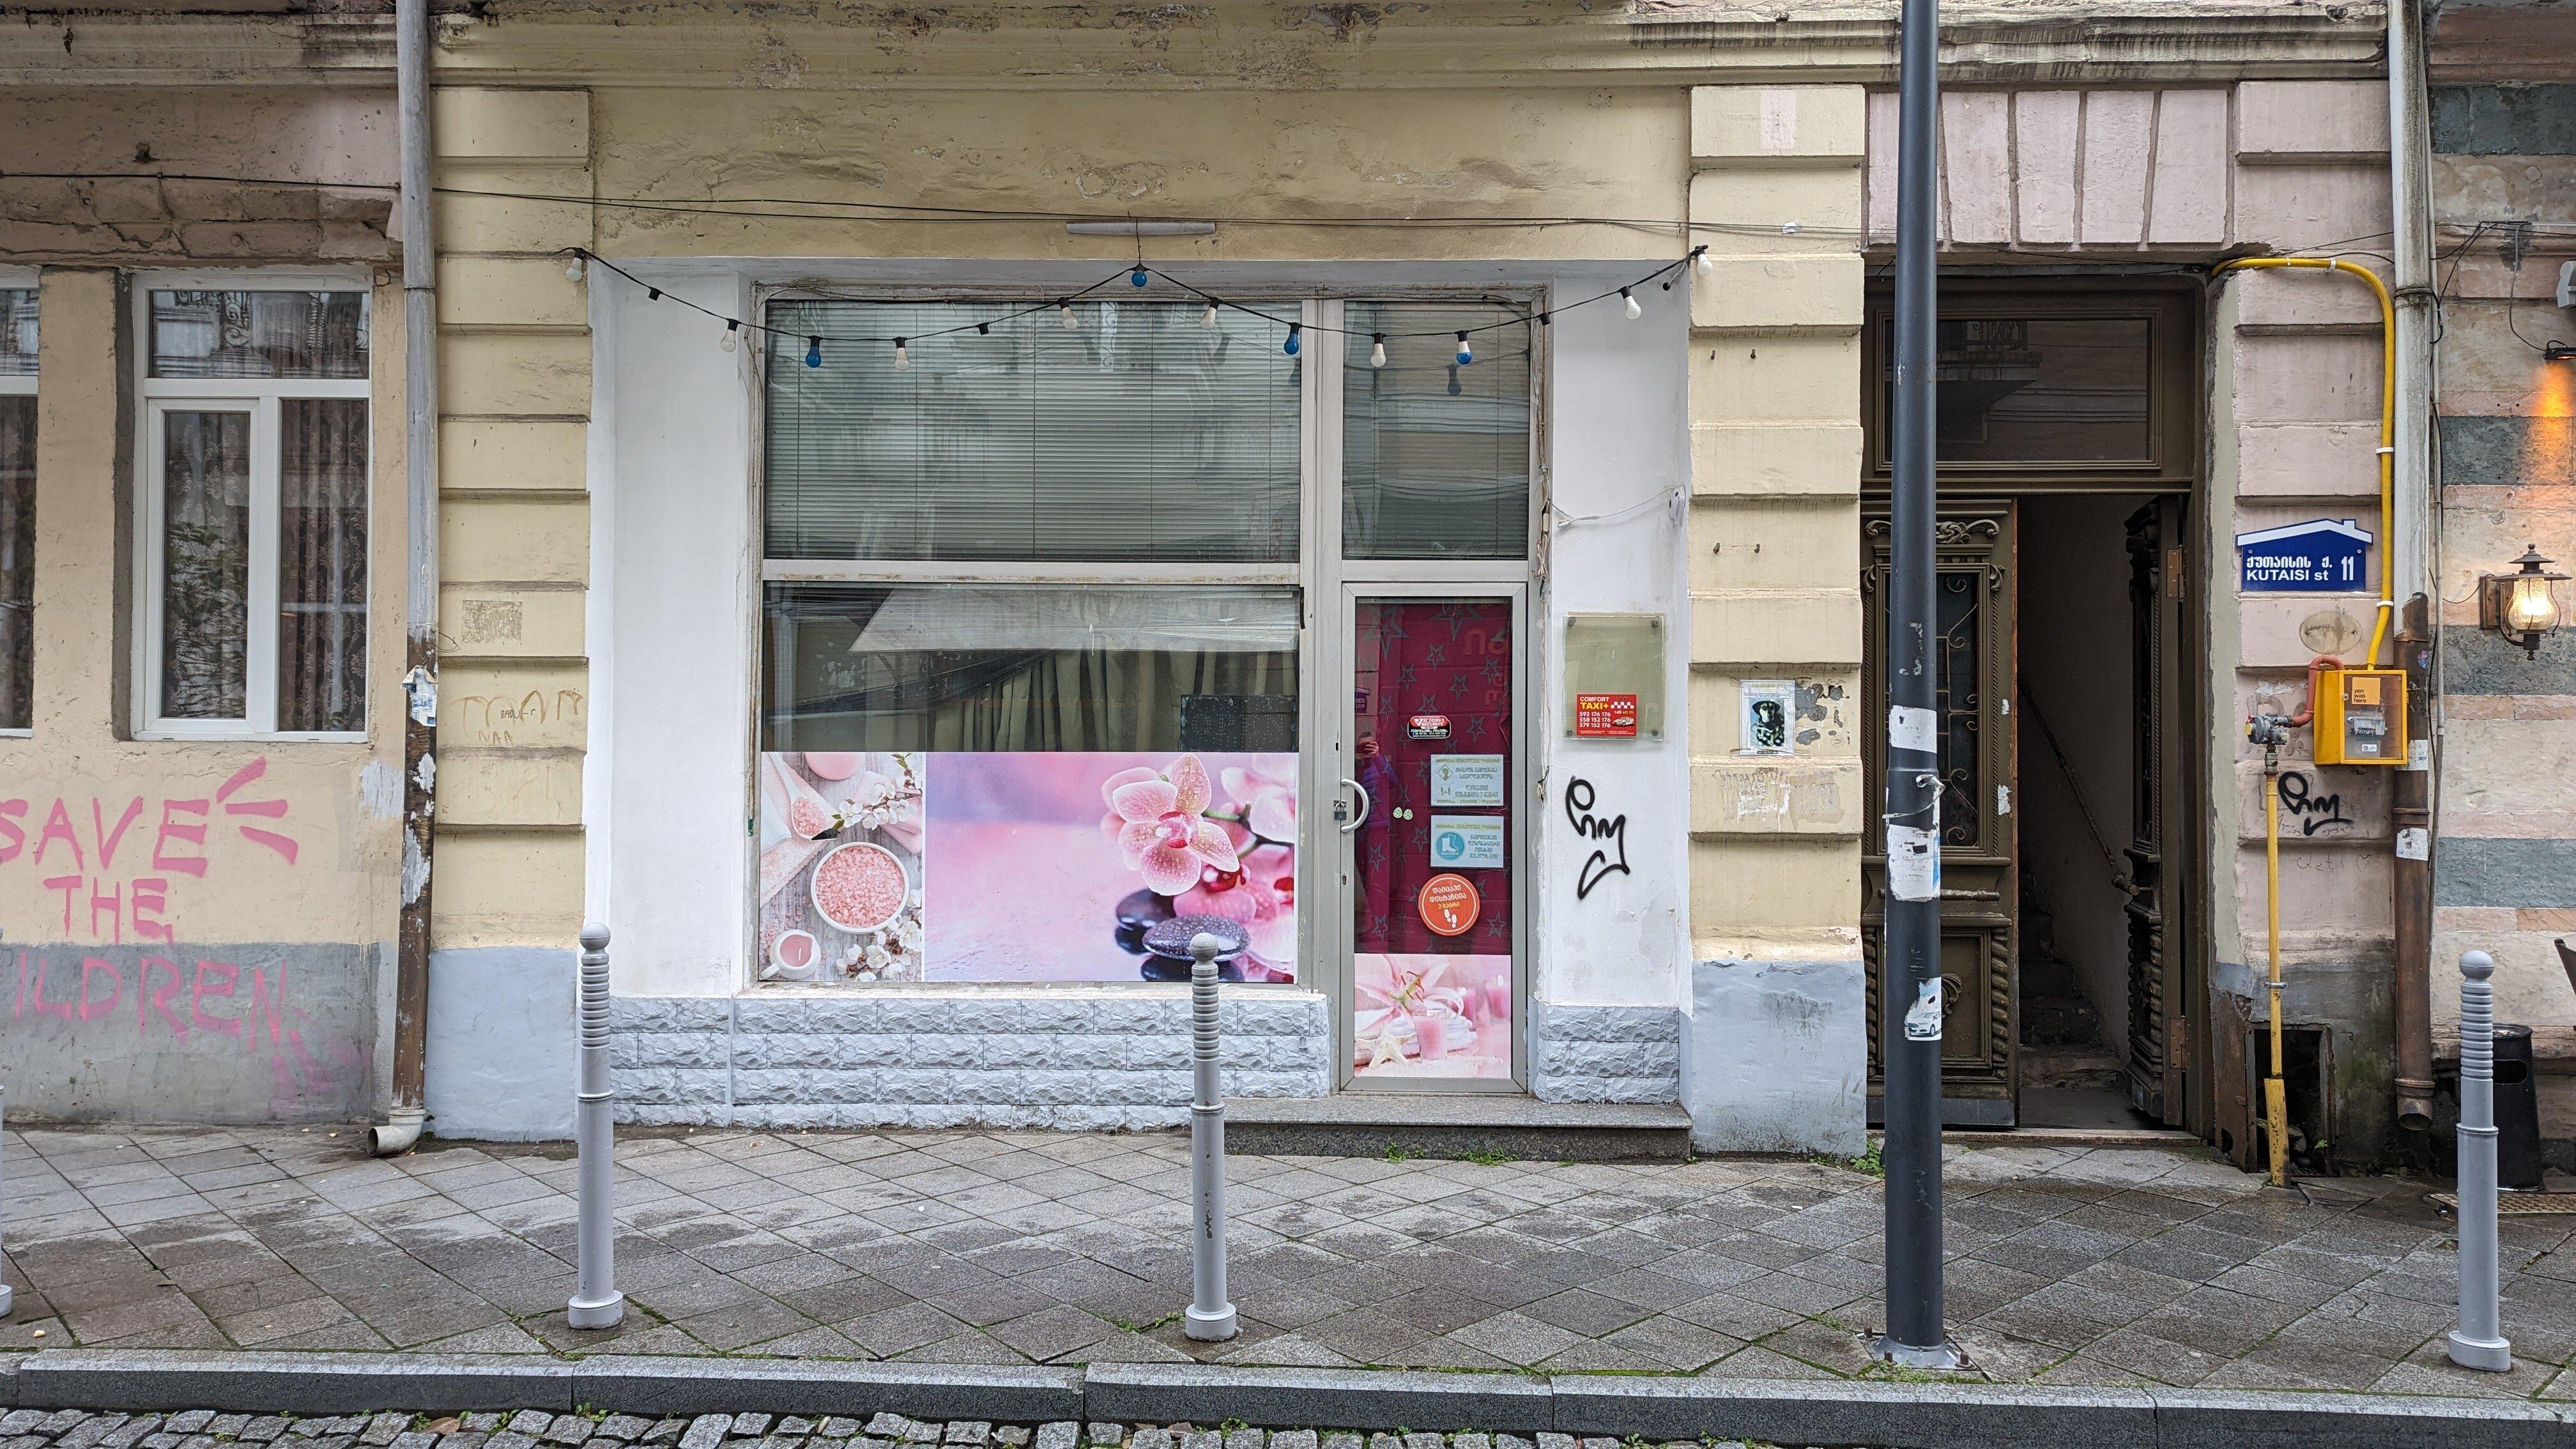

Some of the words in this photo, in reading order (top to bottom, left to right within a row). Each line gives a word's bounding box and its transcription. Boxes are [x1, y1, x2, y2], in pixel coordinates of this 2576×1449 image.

[2247, 570, 2309, 581] KUTAISI
[2314, 571, 2328, 581] st
[2342, 556, 2354, 580] 11
[1192, 714, 1286, 735] OPEN
[0, 796, 210, 877] SAVE
[1429, 893, 1467, 902] დისტანცია
[1432, 885, 1461, 893] დაიცავი
[43, 875, 172, 944] THE
